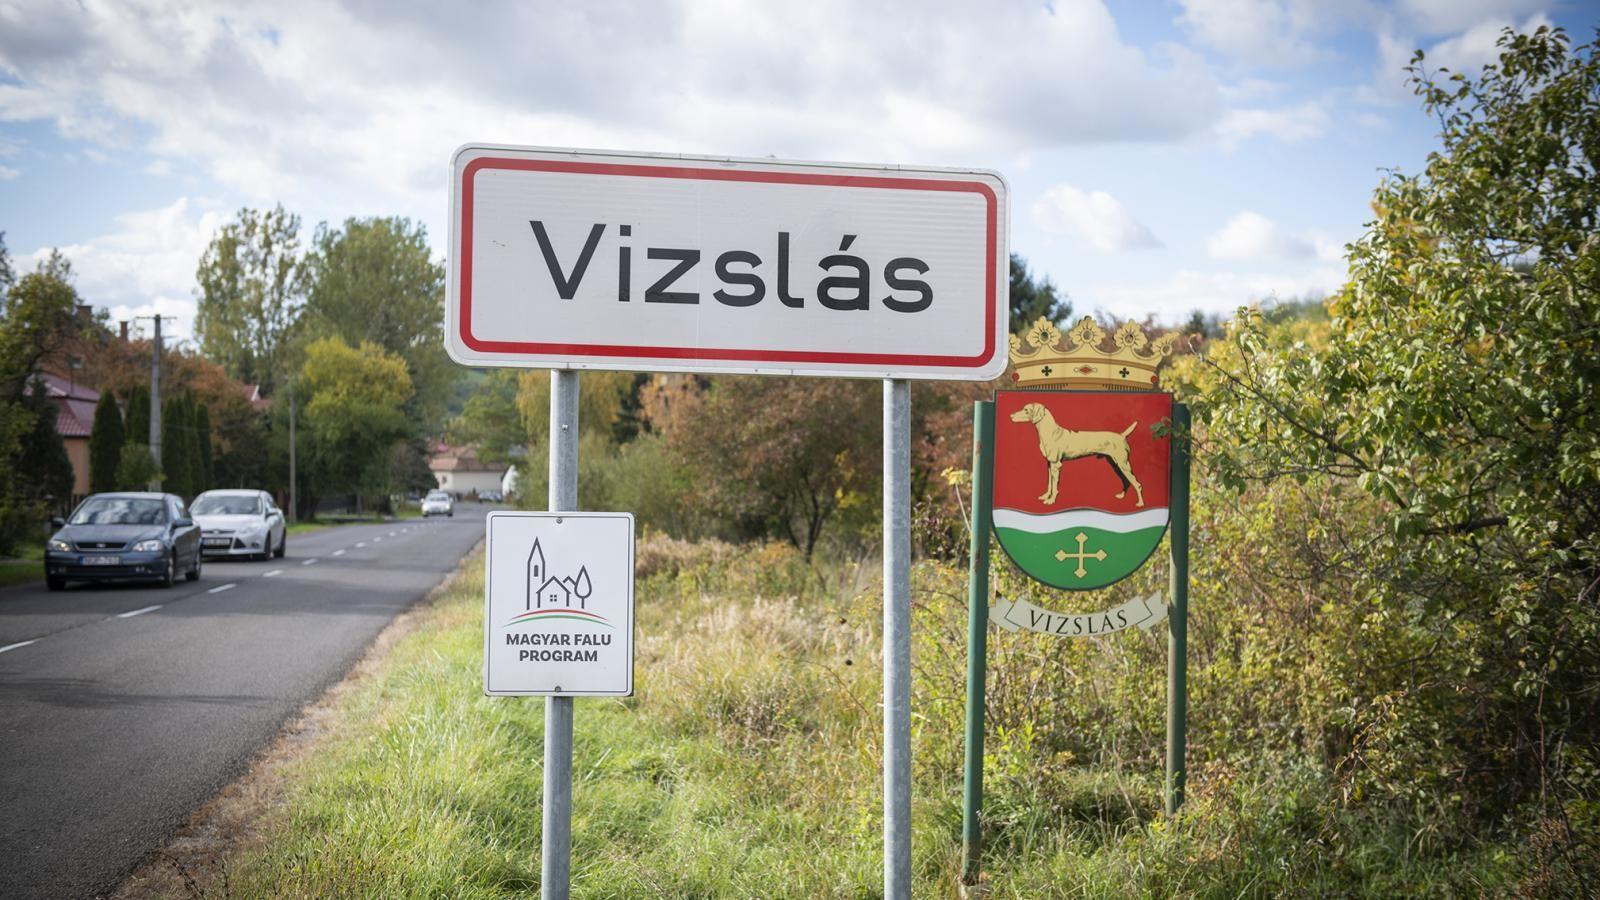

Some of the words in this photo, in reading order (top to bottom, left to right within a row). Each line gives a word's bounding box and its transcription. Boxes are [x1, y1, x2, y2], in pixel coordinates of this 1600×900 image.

[529, 220, 934, 313] Vizslás
[1029, 609, 1128, 634] VIZSLÁS
[506, 634, 571, 646] MAGYAR
[574, 634, 611, 646] FALU
[519, 650, 598, 662] PROGRAM
